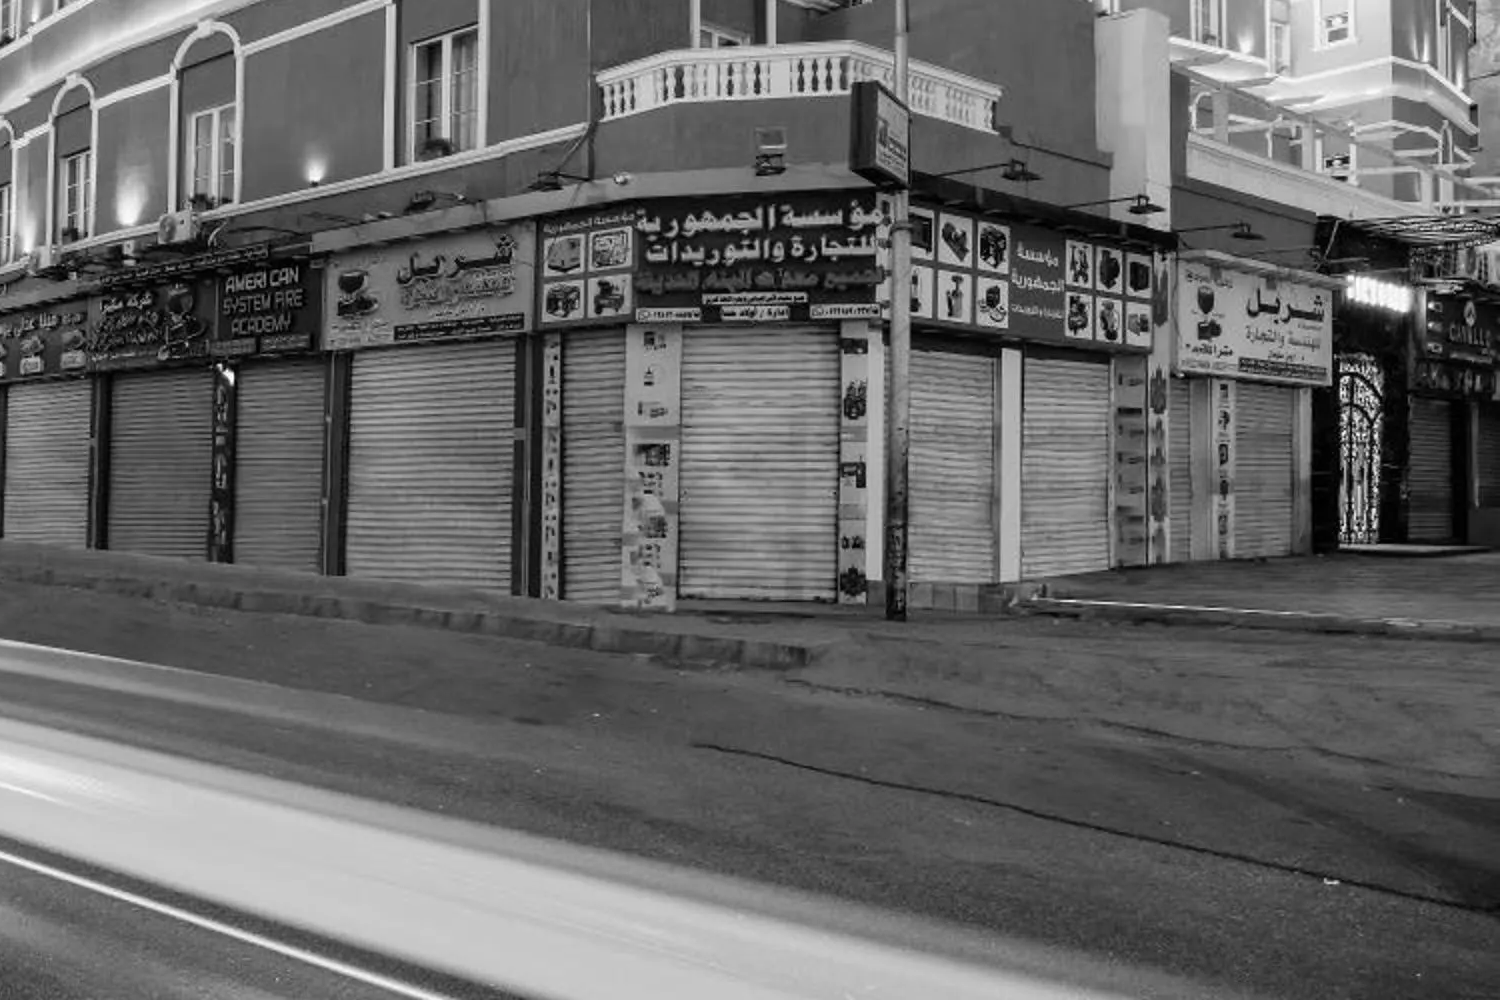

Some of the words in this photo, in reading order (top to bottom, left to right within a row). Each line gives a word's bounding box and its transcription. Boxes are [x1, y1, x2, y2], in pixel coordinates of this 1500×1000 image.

[636, 203, 777, 238] الجمهورية
[781, 201, 884, 231] مؤسسة
[395, 233, 515, 285] شربل
[645, 236, 785, 266] والتوريدات
[790, 234, 879, 262] للتجارة
[1017, 241, 1059, 268] مؤسسة
[1011, 268, 1065, 295] الجمهورية
[222, 293, 271, 316] SYSTEM
[1246, 287, 1325, 325] شربل
[231, 311, 292, 336] ACADEMY
